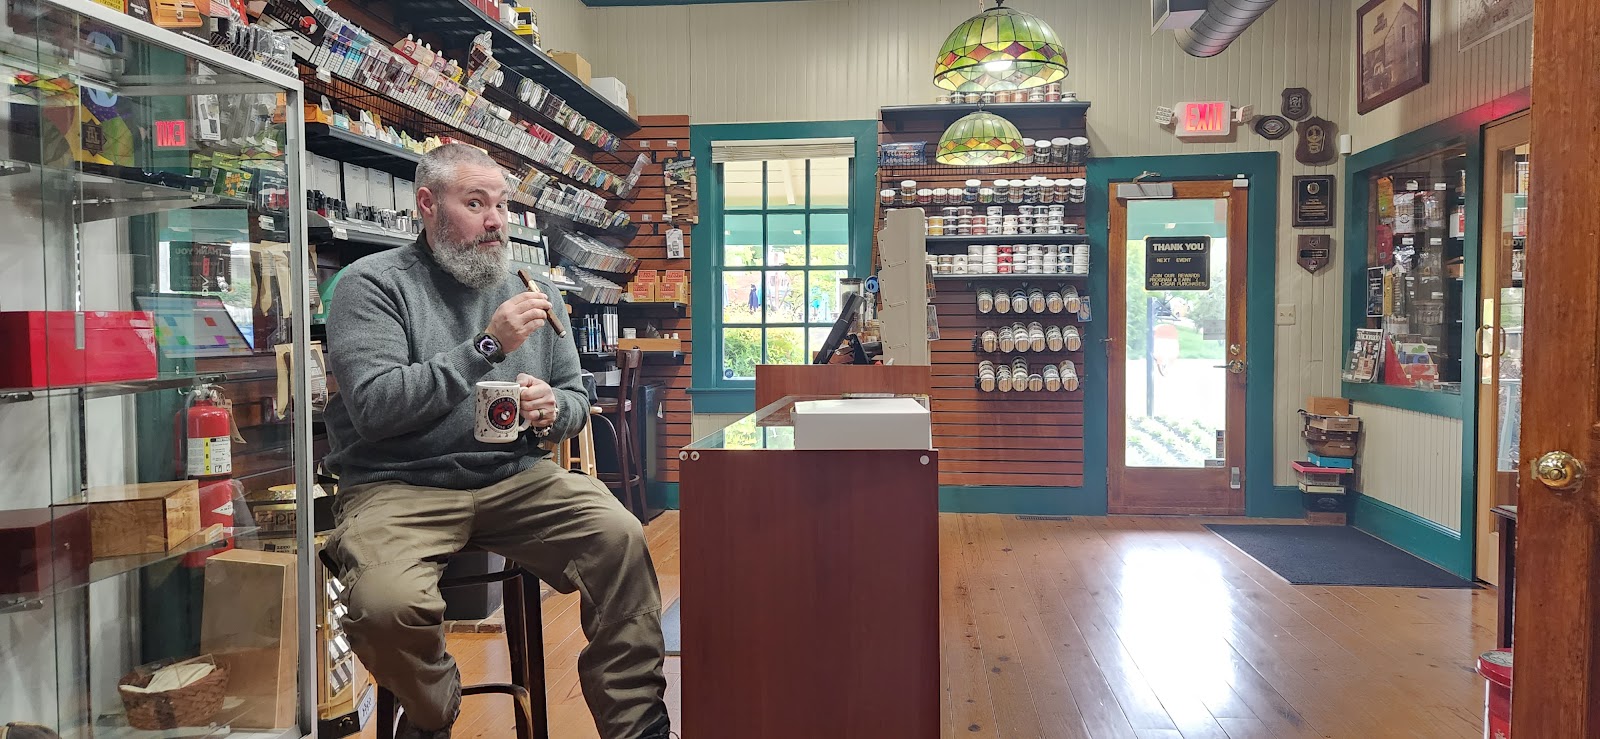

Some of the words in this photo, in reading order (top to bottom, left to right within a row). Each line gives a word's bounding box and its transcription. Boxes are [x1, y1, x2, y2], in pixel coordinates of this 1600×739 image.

[272, 6, 298, 25] SPIRIT
[1185, 103, 1224, 131] EXIT
[1152, 243, 1184, 251] THANK
[1185, 243, 1204, 251] YOU
[257, 511, 297, 526] zipp
